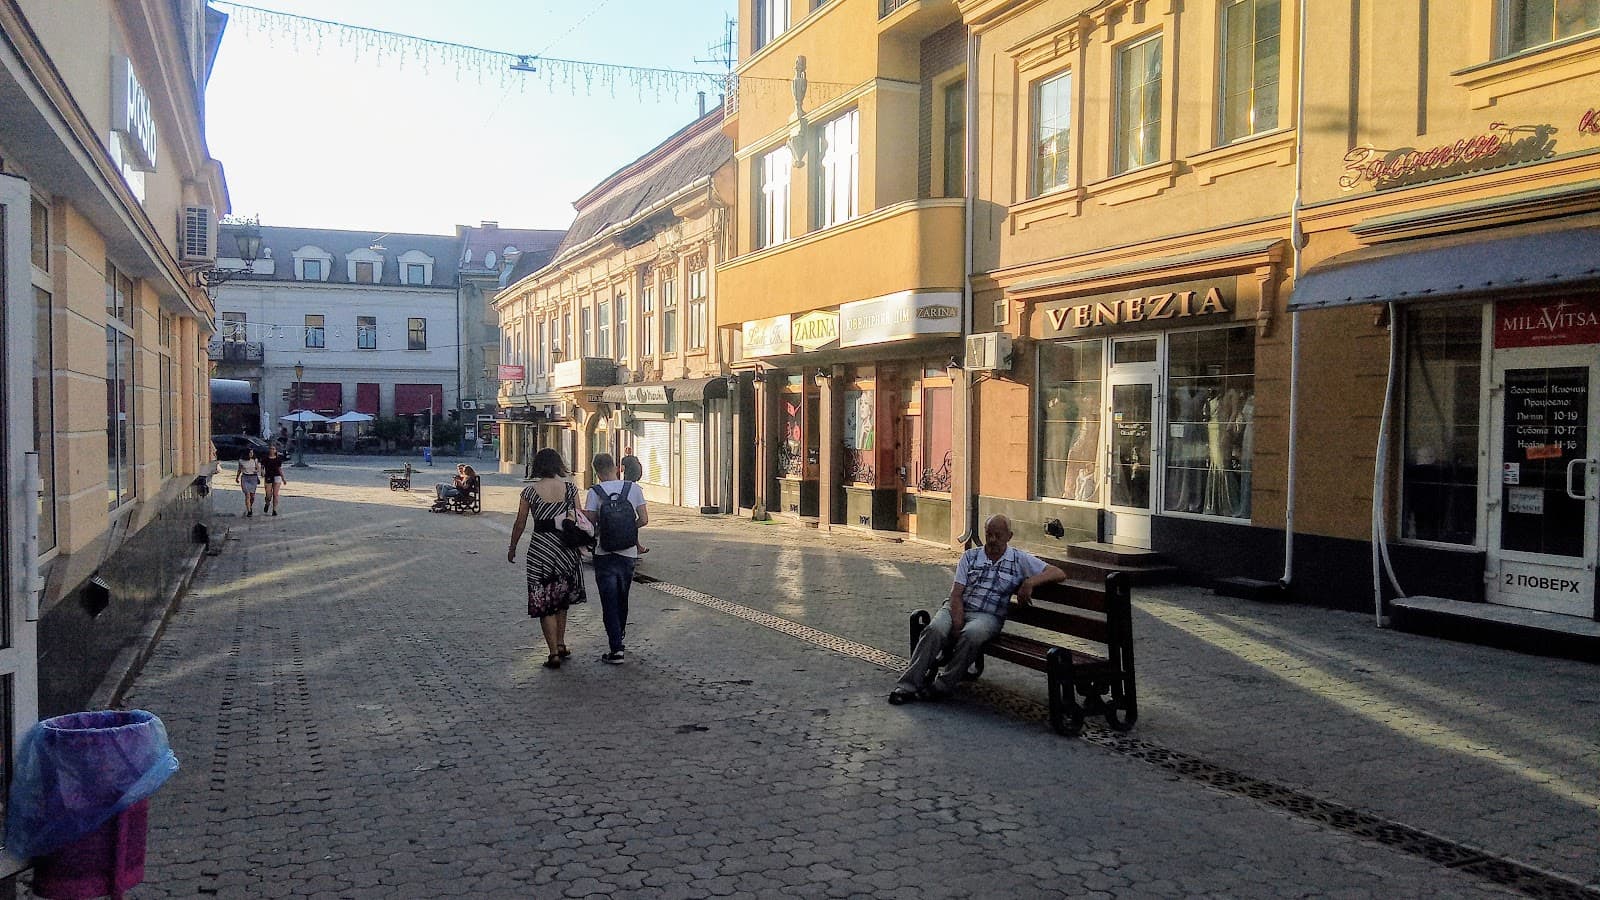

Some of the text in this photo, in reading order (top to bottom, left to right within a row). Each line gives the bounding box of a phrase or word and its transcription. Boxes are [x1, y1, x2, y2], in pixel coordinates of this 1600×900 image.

[127, 58, 157, 168] prosto
[918, 306, 957, 319] ZARINA
[1045, 287, 1229, 331] VENEZIA
[794, 317, 837, 342] ZARINA
[1554, 411, 1578, 421] 10-19
[1554, 425, 1577, 435] 10-17
[1505, 573, 1580, 594] 2 ПОВЕРХ
